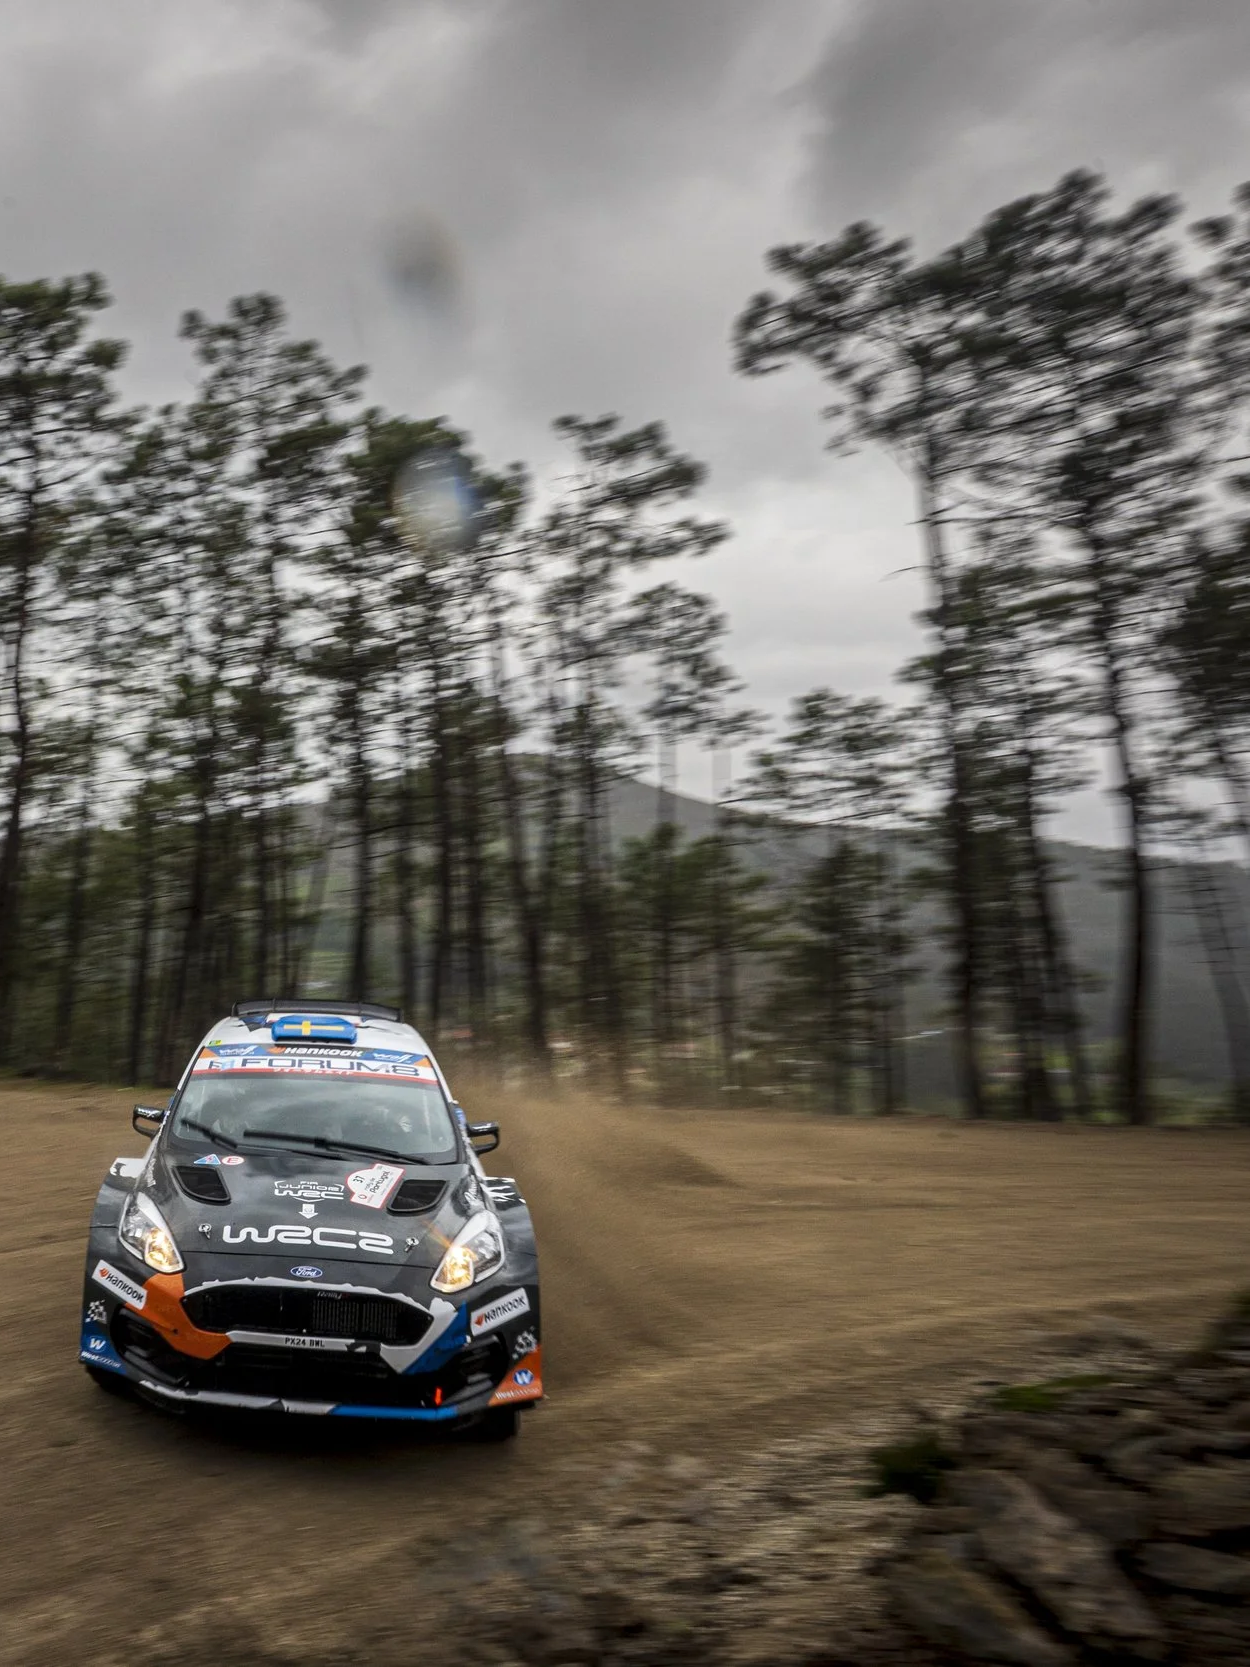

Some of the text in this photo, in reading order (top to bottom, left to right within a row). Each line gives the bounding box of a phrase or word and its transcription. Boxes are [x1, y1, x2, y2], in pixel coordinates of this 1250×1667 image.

[241, 1058, 420, 1077] FORUM8
[352, 1175, 365, 1184] 37
[369, 1170, 390, 1193] Portugal
[279, 1182, 340, 1192] JUNIOR
[274, 1189, 344, 1200] WRC
[222, 1224, 394, 1255] WRC2
[295, 1267, 318, 1277] Ford
[89, 1337, 106, 1351] W
